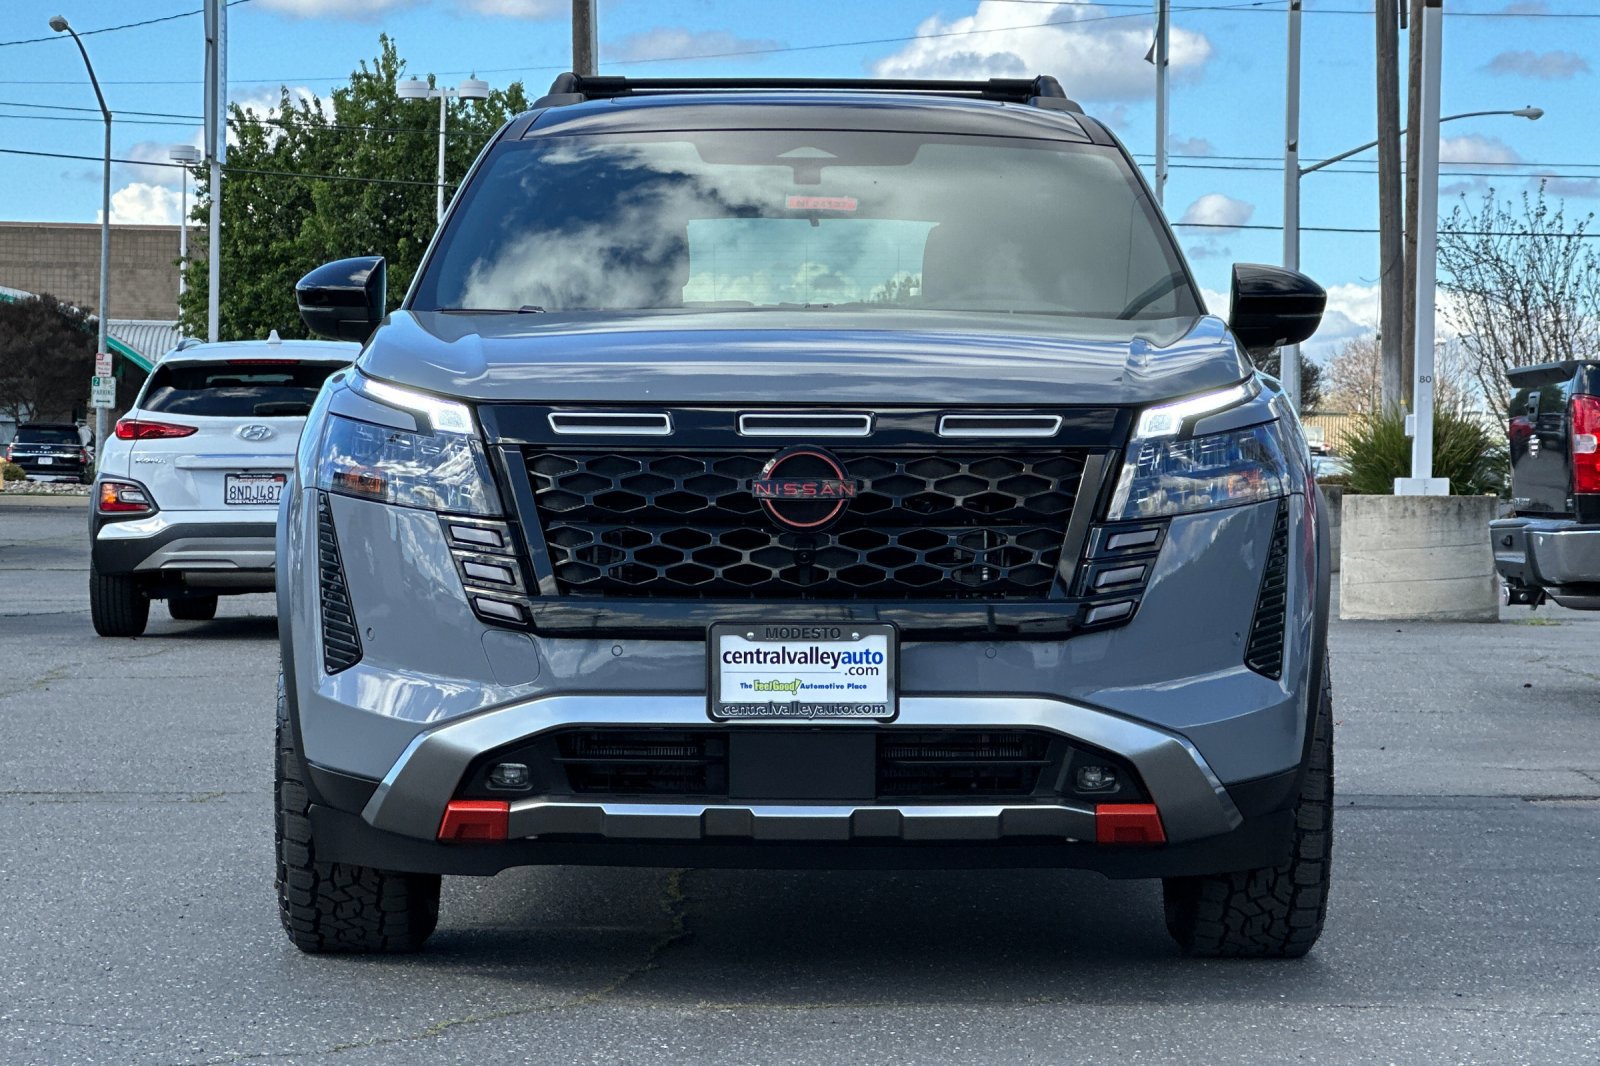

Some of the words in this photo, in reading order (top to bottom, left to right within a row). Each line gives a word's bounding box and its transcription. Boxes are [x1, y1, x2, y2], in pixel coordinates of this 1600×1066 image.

[1419, 375, 1432, 383] 80
[229, 485, 281, 500] 8NDJ487
[755, 483, 854, 496] NISSAN
[765, 627, 841, 639] MODESTO
[722, 646, 884, 669] centralvalleyauto
[844, 666, 879, 676] .com
[800, 682, 844, 690] Automotive
[847, 682, 867, 690] Place
[721, 700, 886, 718] centralvalleyauto.com
